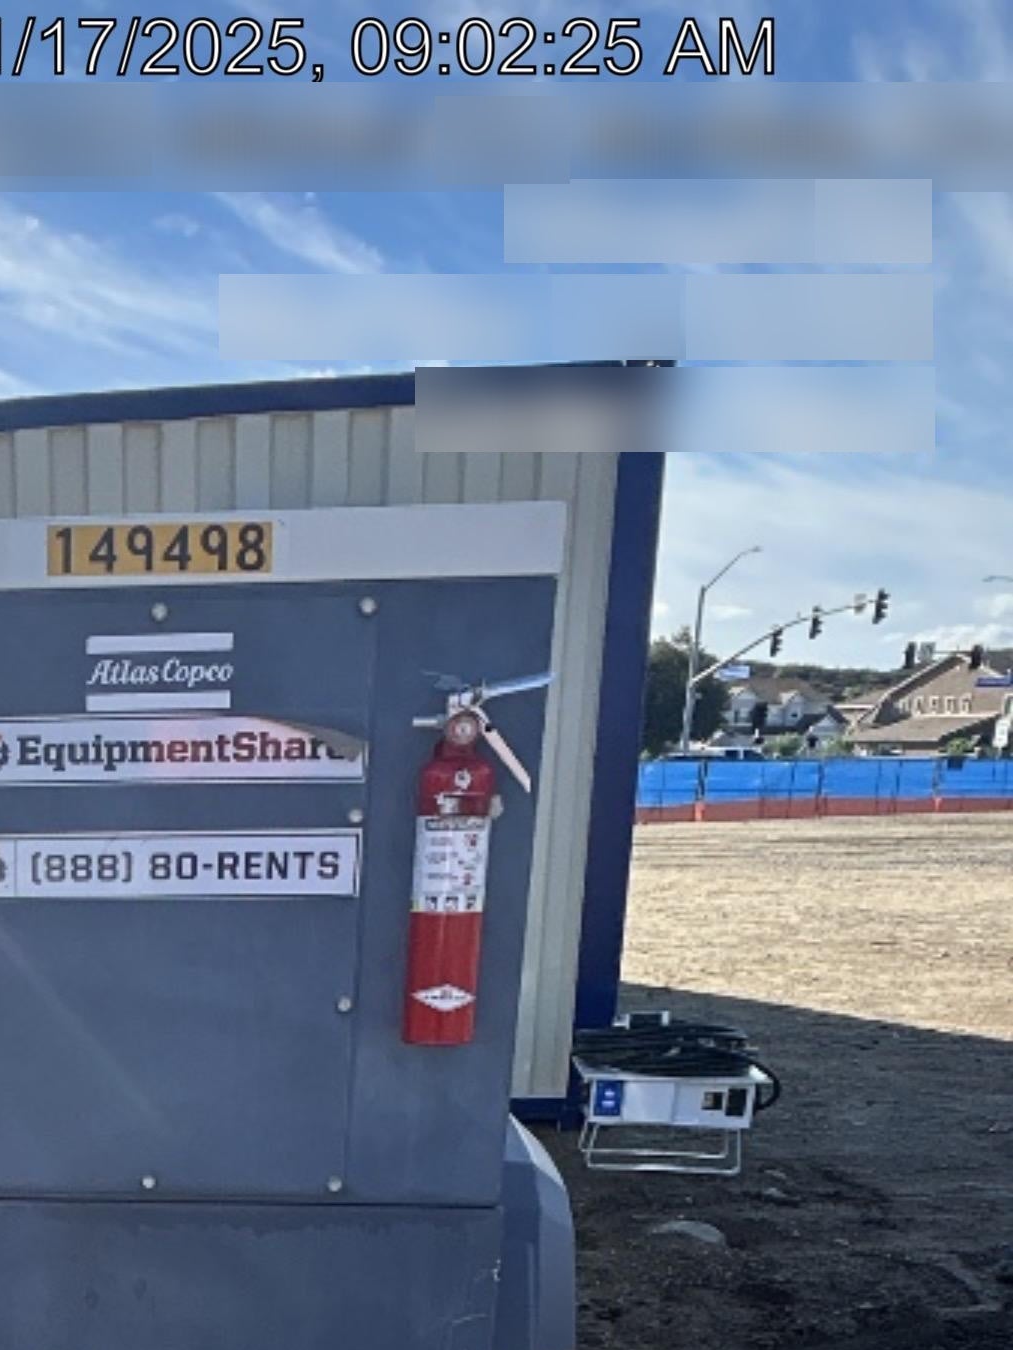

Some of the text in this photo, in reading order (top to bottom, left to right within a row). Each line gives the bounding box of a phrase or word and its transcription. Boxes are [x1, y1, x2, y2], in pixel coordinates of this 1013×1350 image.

[54, 523, 266, 574] 149498
[86, 656, 234, 688] Atlas Copco
[31, 850, 340, 884] (888) 80-RENTS
